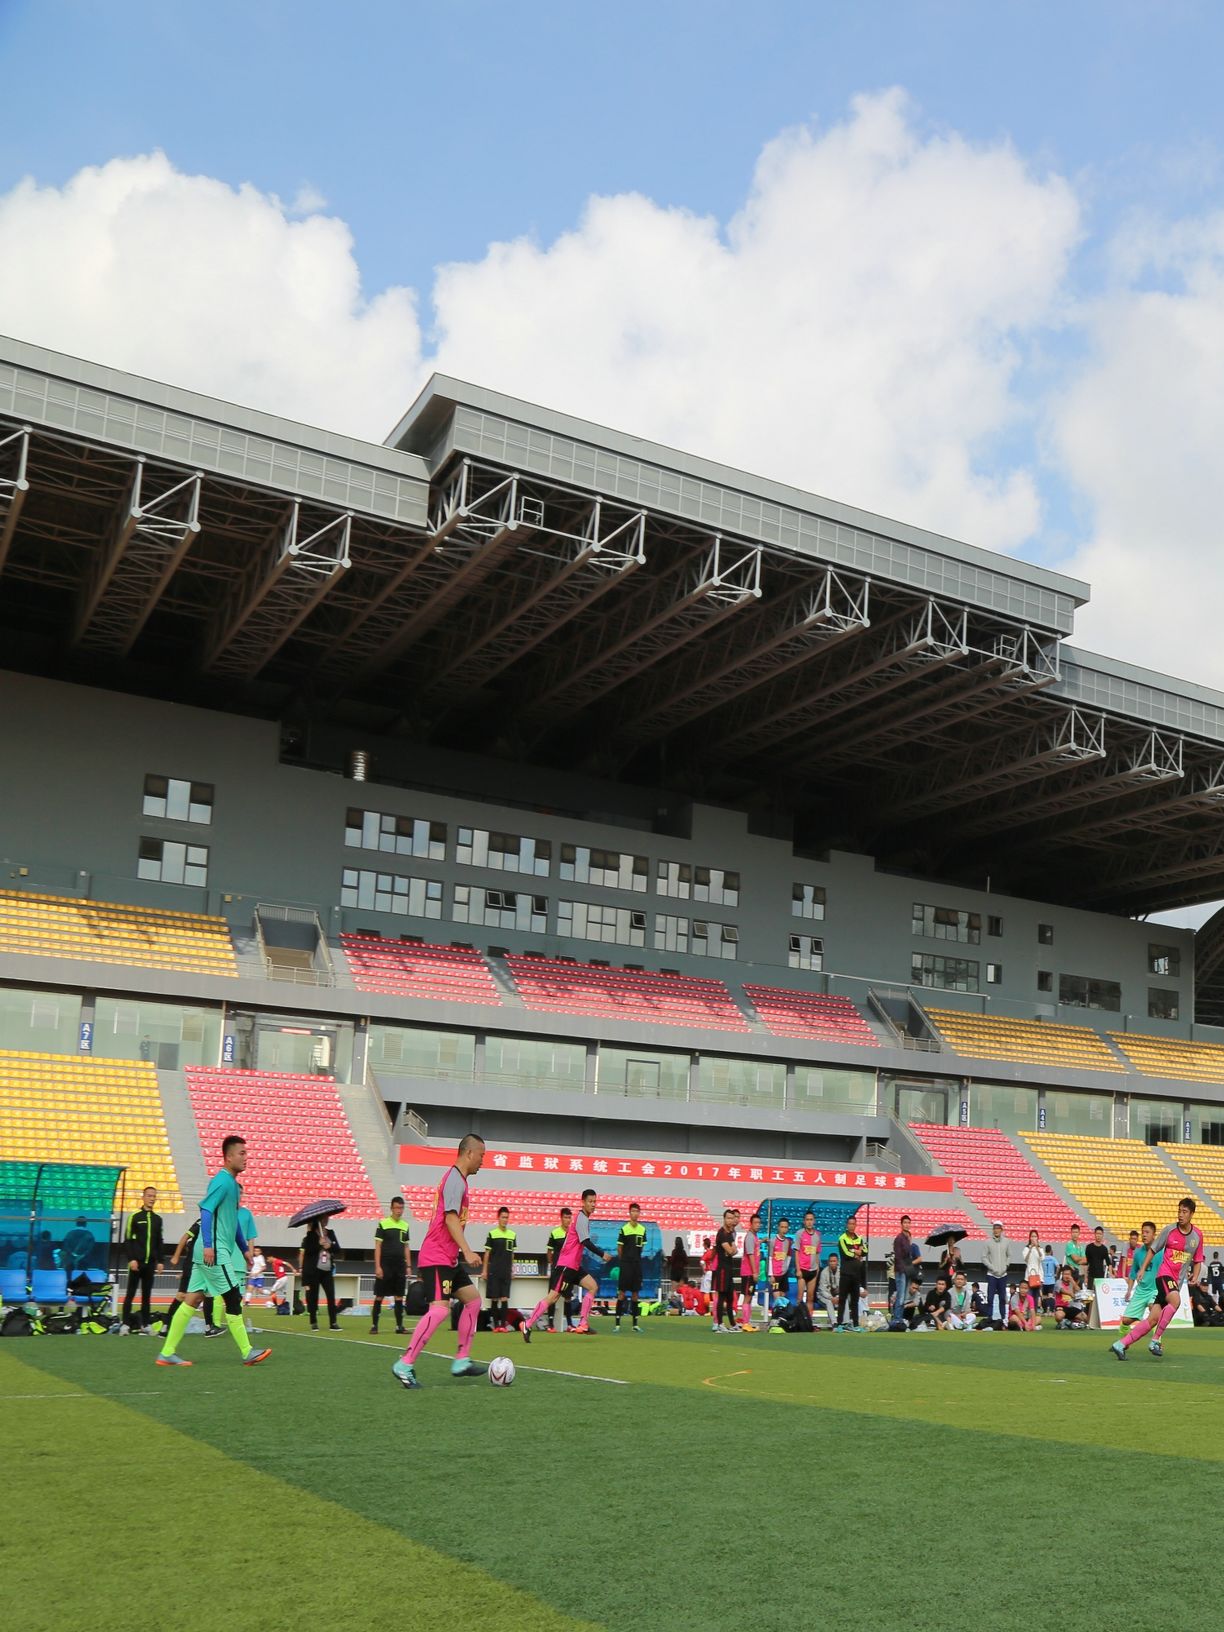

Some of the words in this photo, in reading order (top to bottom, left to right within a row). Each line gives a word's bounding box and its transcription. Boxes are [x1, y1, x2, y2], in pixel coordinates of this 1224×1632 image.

[80, 1023, 92, 1050] A7区
[223, 1036, 234, 1062] A6区
[493, 1153, 907, 1188] 省监狱系统工会2017年职工五人制足球赛
